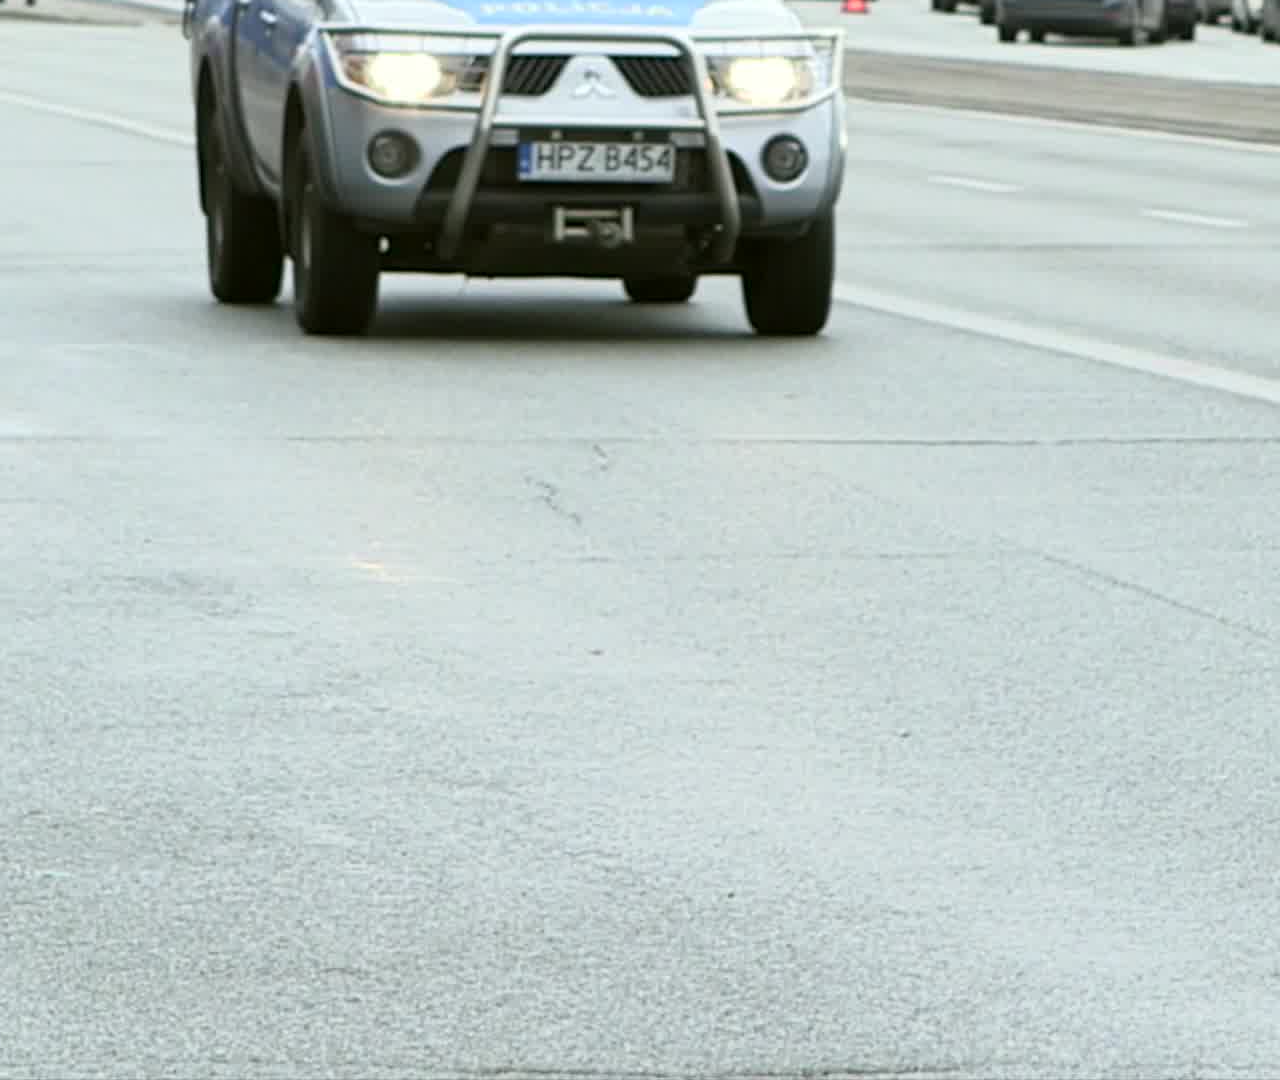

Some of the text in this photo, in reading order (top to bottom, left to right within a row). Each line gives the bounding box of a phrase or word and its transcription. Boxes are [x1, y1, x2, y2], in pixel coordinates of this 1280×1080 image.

[480, 0, 674, 17] POLICJA
[537, 145, 670, 172] HPZ B454
